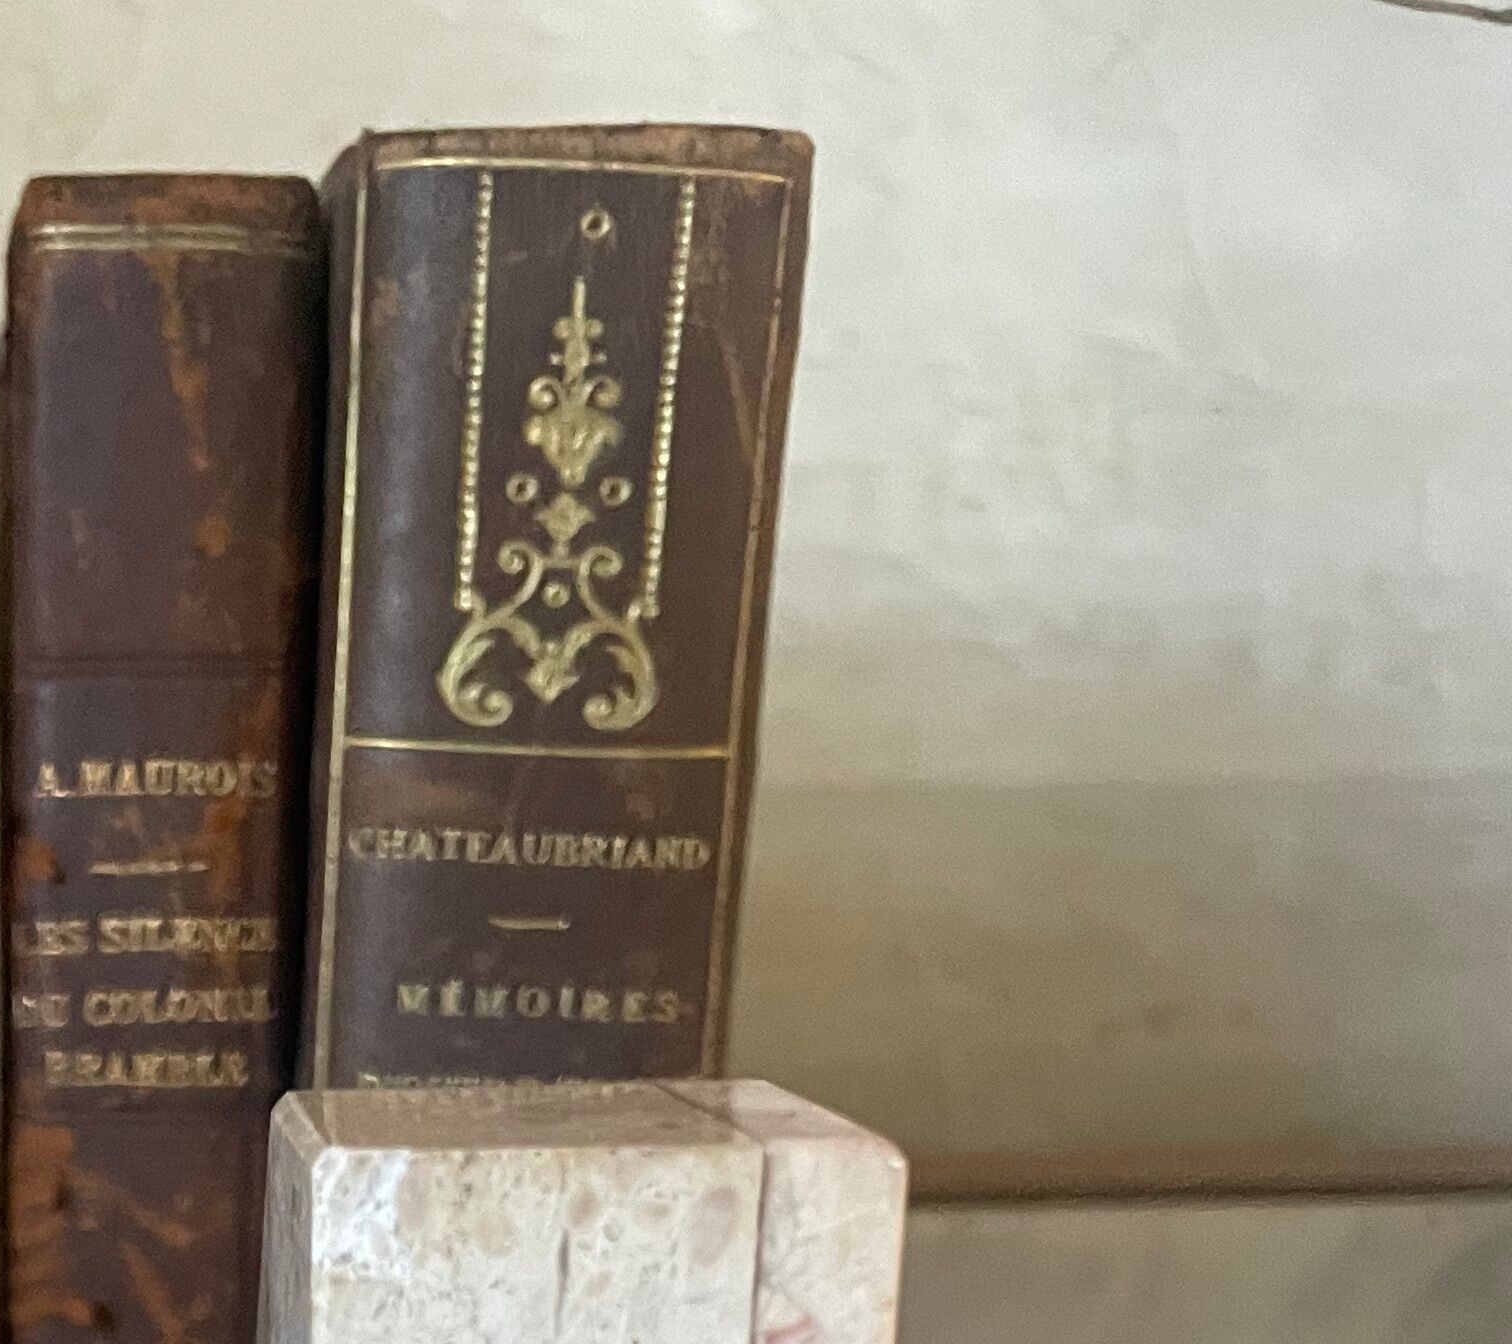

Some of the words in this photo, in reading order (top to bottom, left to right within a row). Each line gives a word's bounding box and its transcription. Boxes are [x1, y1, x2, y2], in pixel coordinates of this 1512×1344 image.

[78, 757, 278, 798] MAUROIS
[347, 825, 711, 870] CHATEAUBRIAND
[13, 919, 88, 957] LES
[396, 978, 683, 1024] MÉMOIRES
